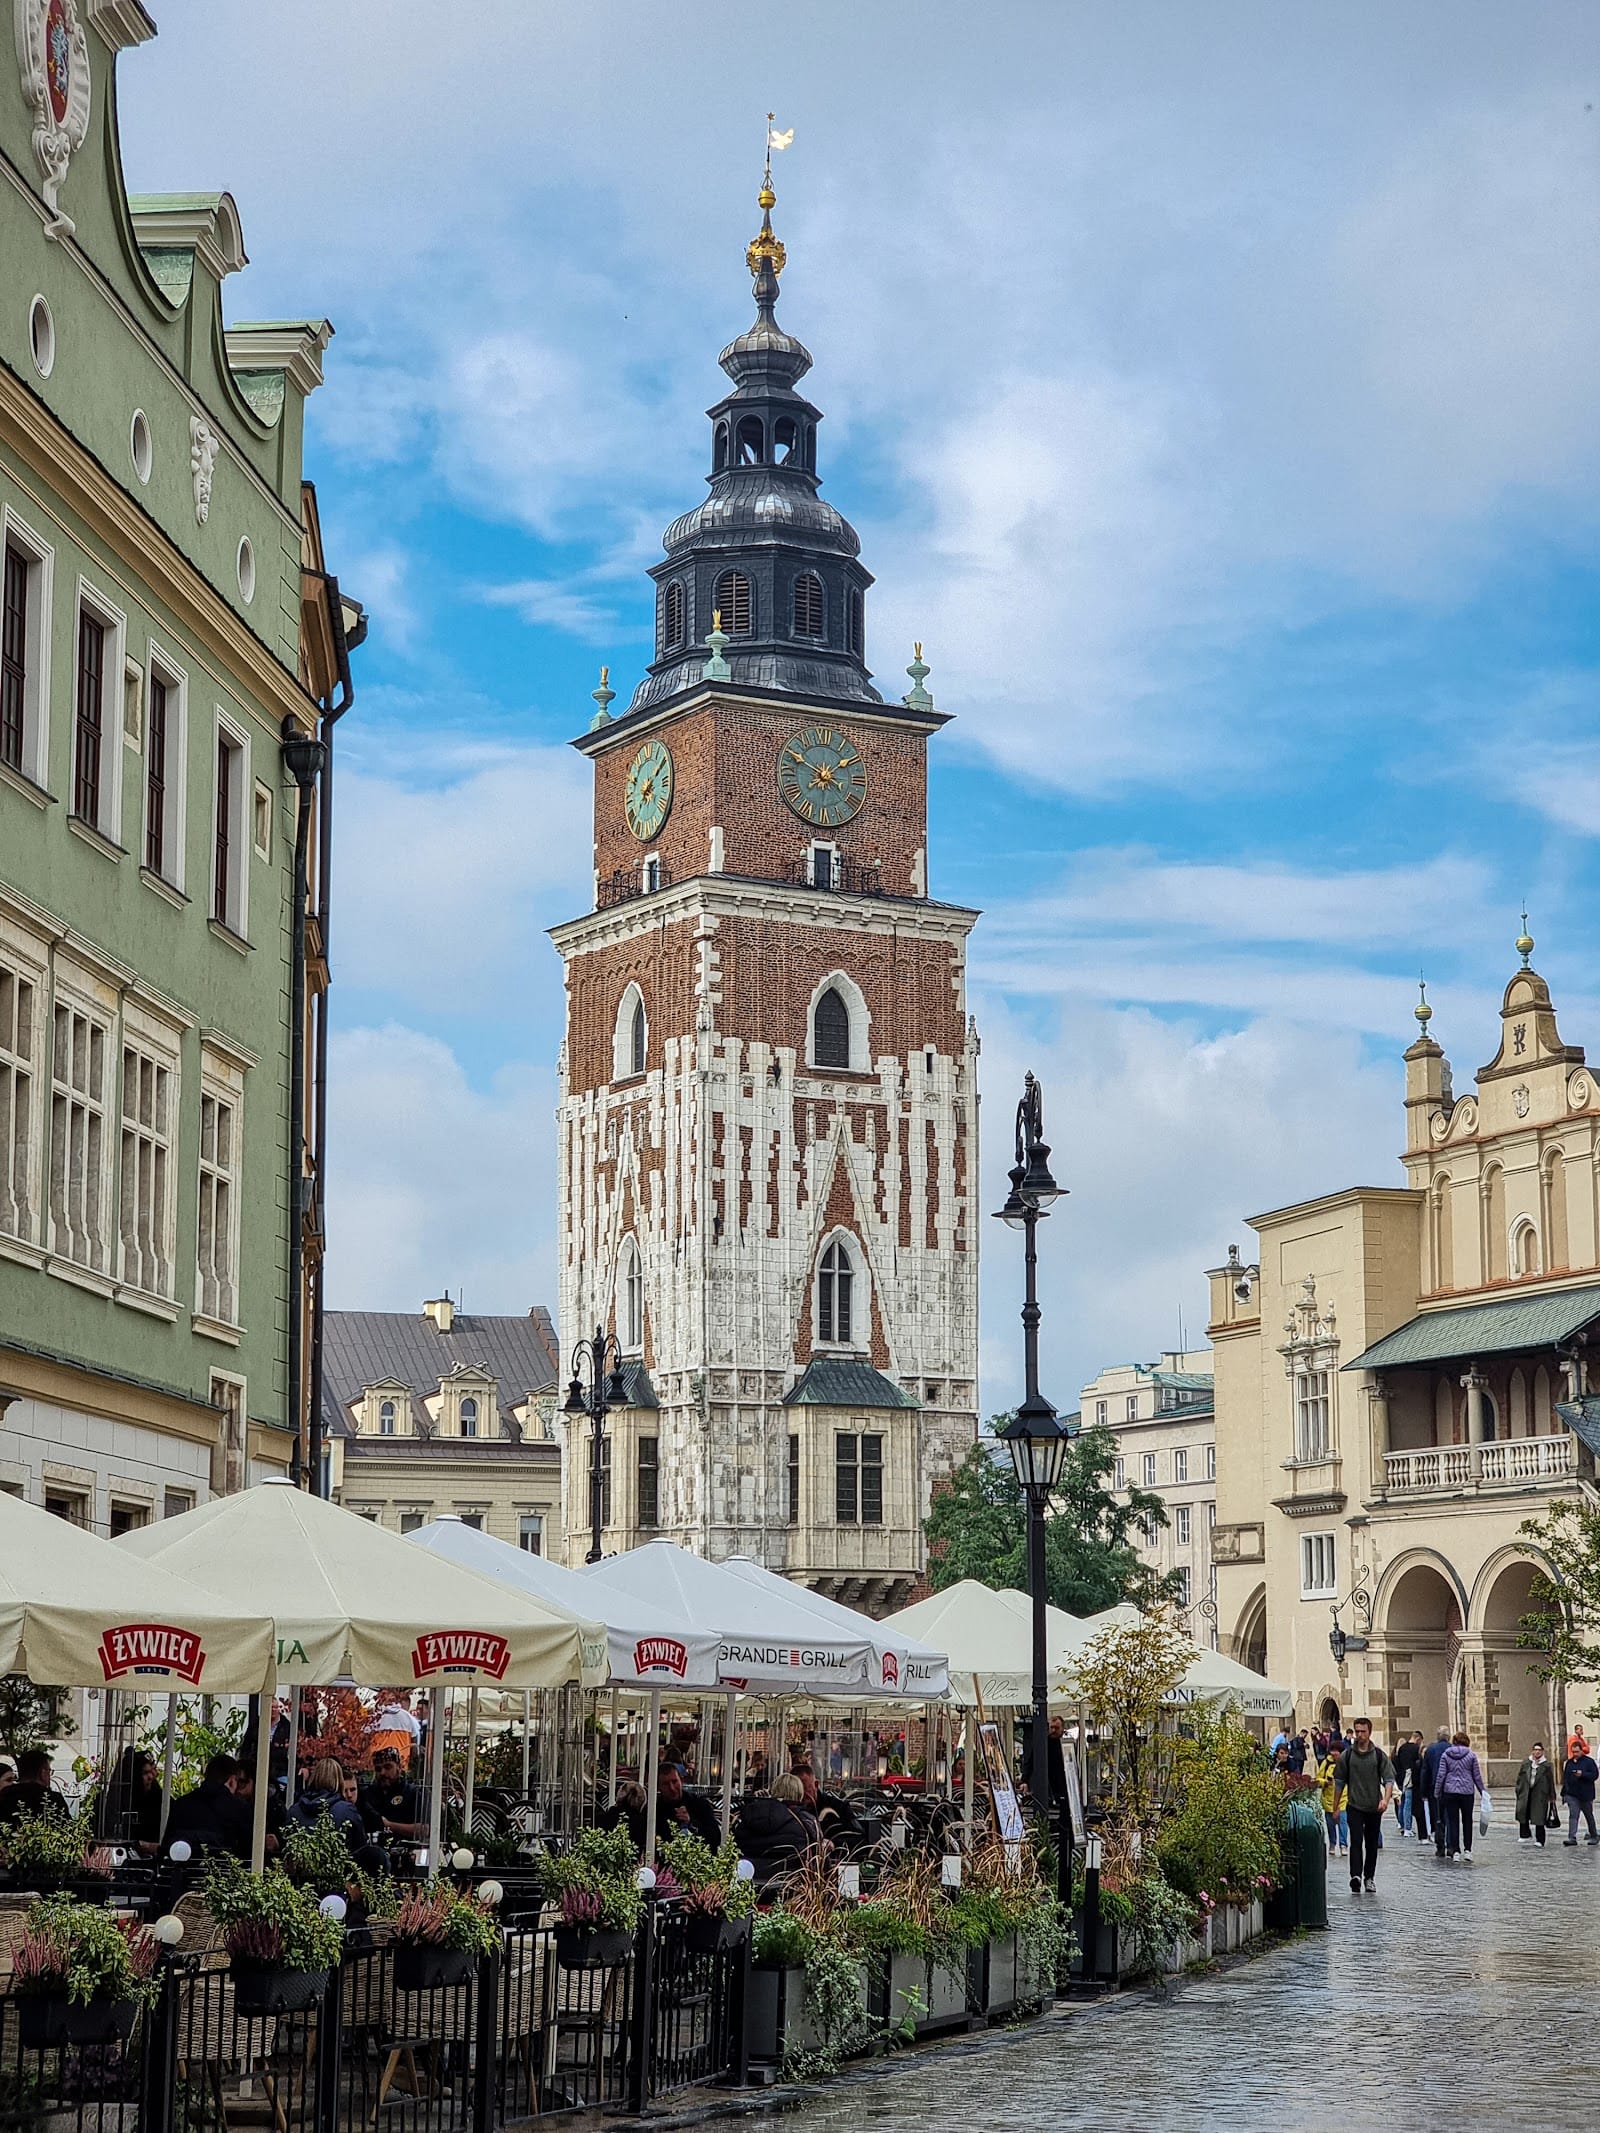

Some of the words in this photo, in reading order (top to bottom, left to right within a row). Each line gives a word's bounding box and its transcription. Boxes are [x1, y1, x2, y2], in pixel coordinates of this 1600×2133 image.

[112, 1629, 194, 1666] ŻYWIEC
[276, 1639, 310, 1666] JA
[424, 1635, 500, 1665] ŻYWIEC
[641, 1641, 682, 1665] ŻYWIEC
[718, 1645, 789, 1665] GRANDE
[801, 1650, 847, 1668] GRILL
[906, 1664, 931, 1679] RILL
